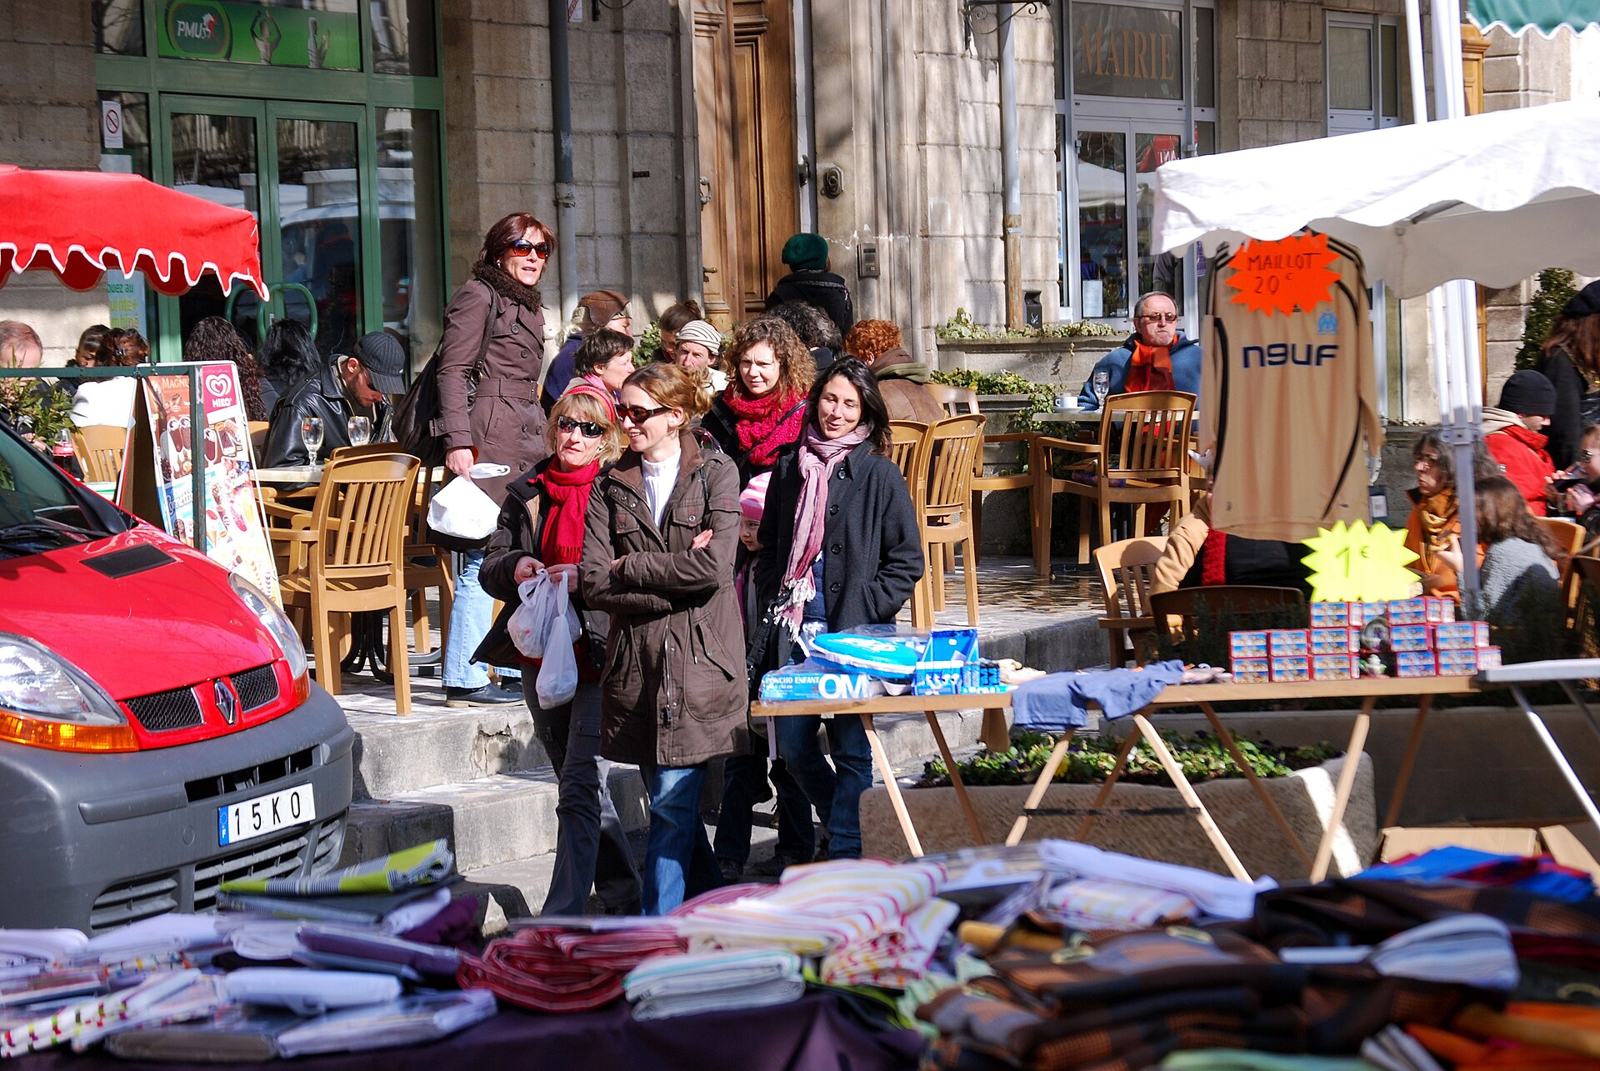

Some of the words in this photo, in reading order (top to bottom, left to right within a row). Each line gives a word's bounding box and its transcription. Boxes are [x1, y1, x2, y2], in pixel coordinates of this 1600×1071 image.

[176, 20, 203, 39] PMU
[1081, 24, 1175, 80] MAIRIE
[1248, 252, 1321, 271] MAILLOT
[162, 377, 190, 389] MAGNU
[795, 676, 820, 684] ENFANT
[819, 673, 870, 700] OM
